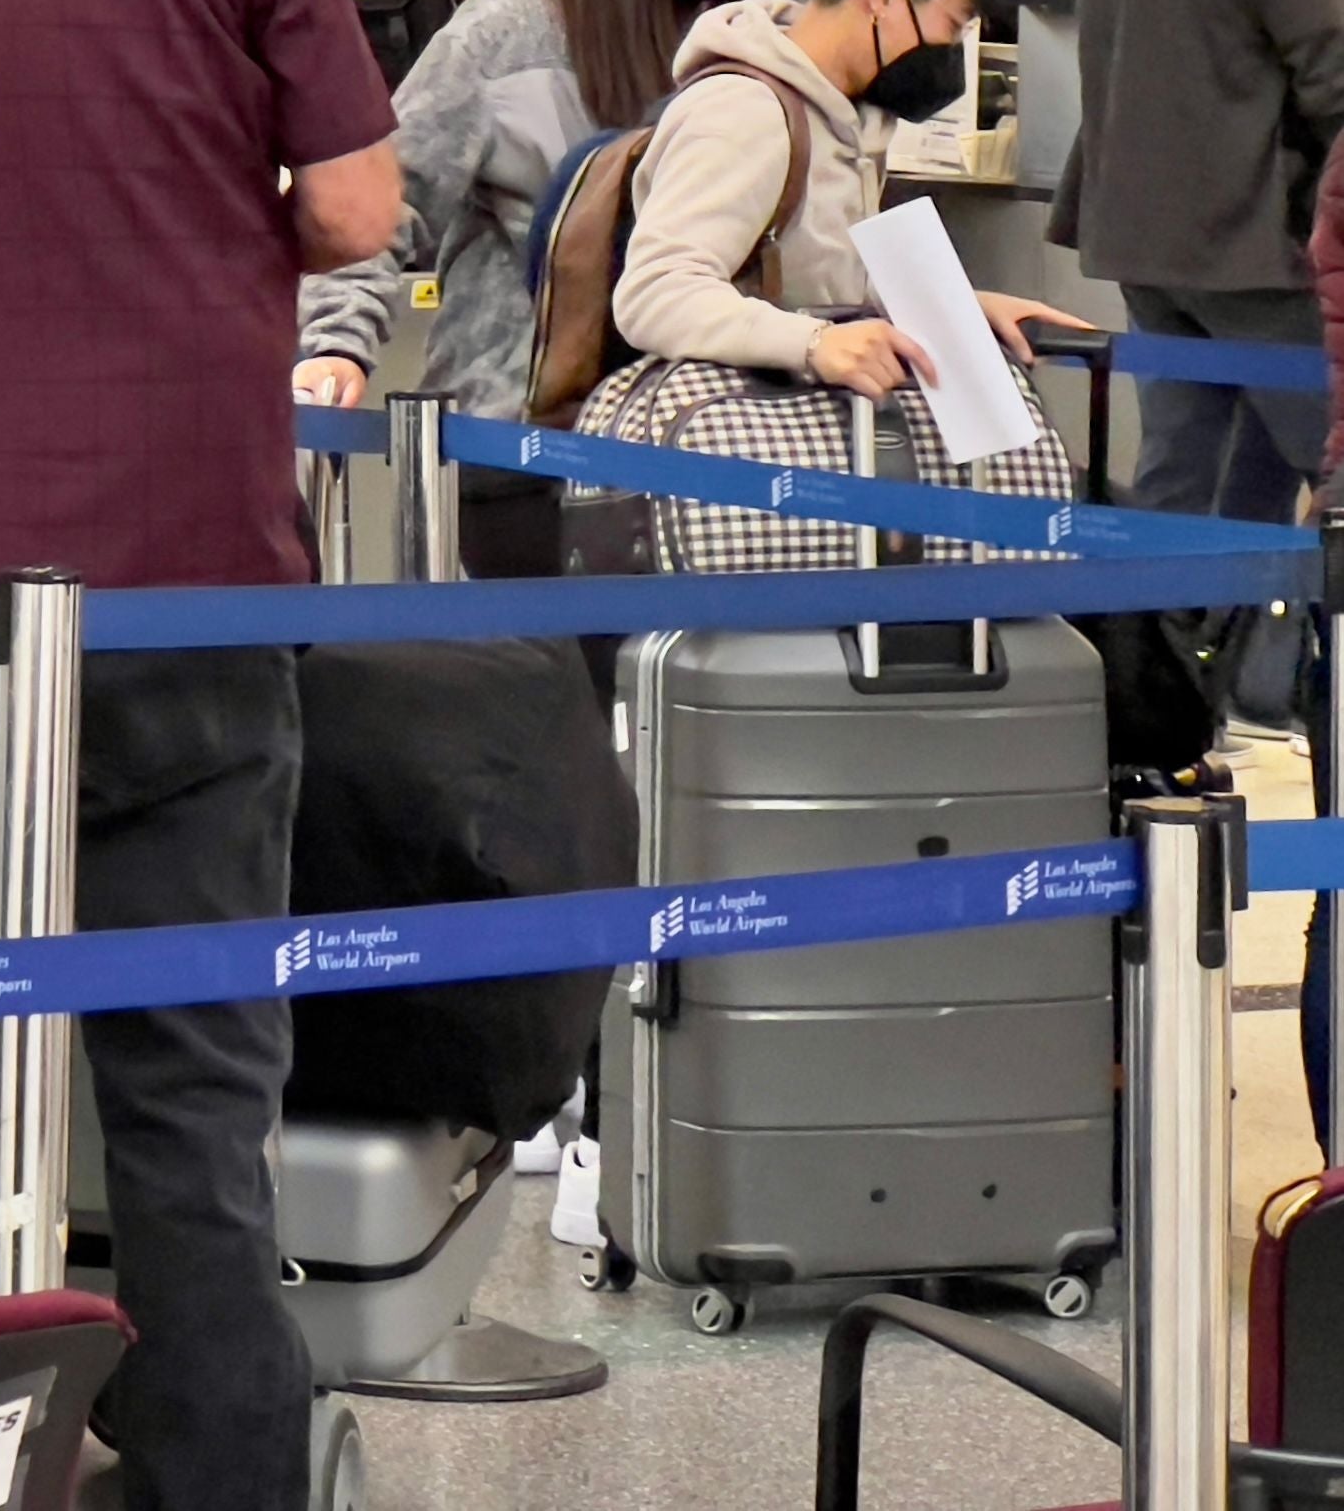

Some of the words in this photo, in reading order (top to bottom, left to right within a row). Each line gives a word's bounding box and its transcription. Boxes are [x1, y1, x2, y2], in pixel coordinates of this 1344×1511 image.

[689, 896, 712, 914] Los
[716, 890, 767, 914] Angeles
[689, 916, 729, 936] World
[731, 914, 788, 936] Airports
[316, 930, 341, 948] Los
[345, 925, 399, 949] Angeles
[316, 951, 360, 971] World
[363, 950, 421, 972] Airports
